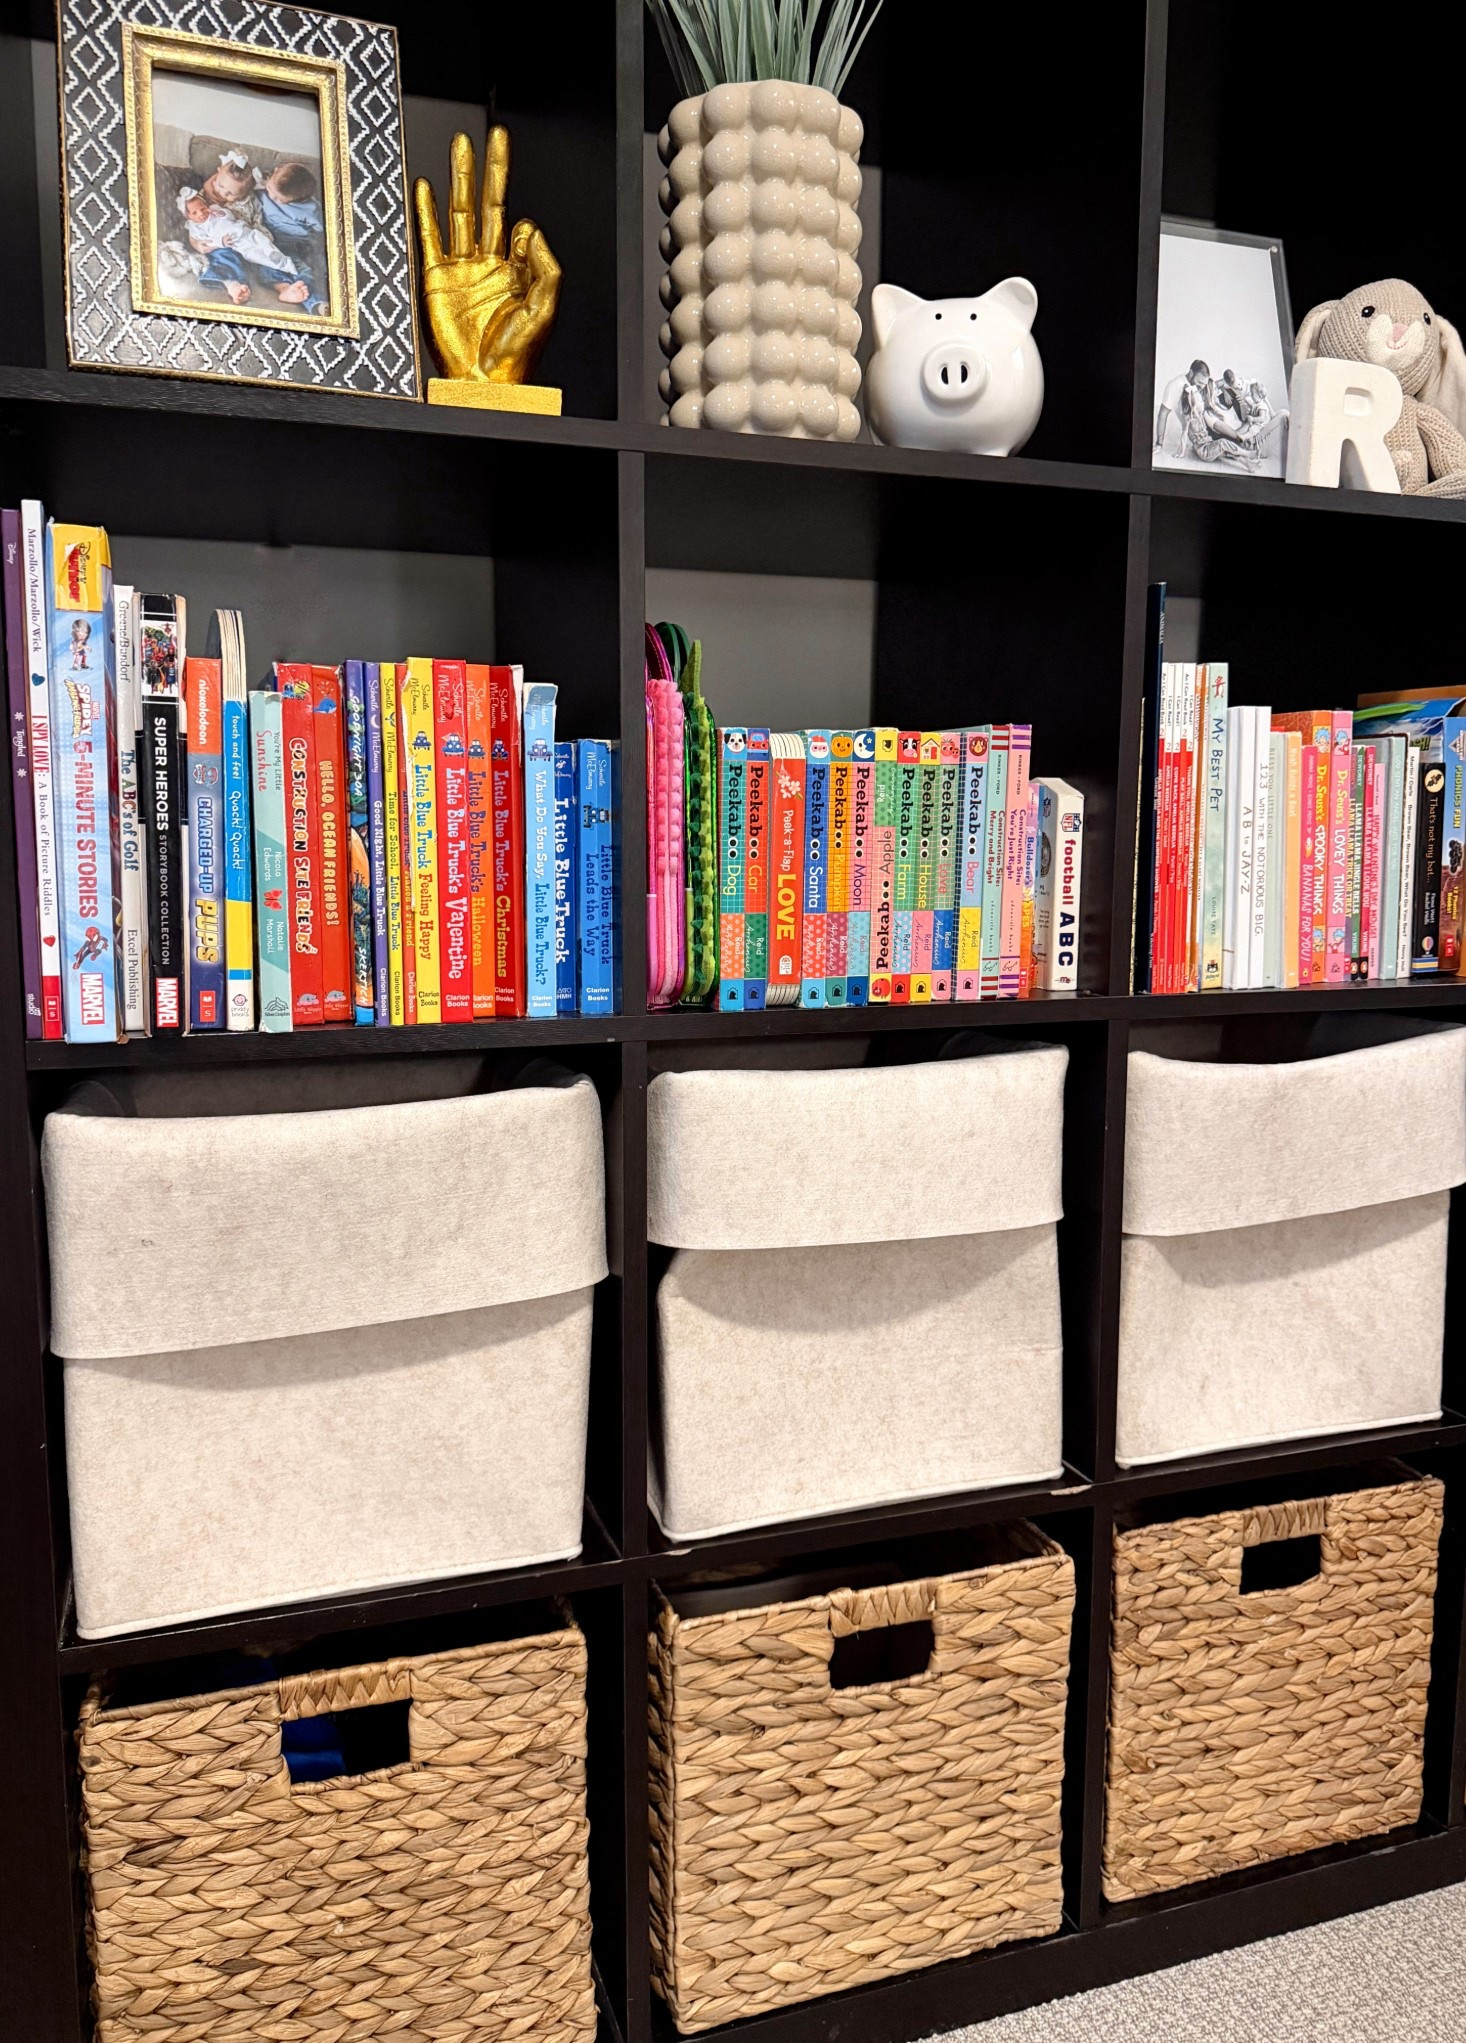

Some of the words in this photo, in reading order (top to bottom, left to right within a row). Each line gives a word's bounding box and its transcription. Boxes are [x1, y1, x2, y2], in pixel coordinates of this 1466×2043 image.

[78, 684, 93, 736] SPIDEY
[198, 680, 209, 744] nickelodeon
[232, 715, 240, 738] touch
[13, 729, 26, 757] Tangled
[33, 722, 48, 742] SPY
[154, 717, 167, 766] SUPER
[232, 742, 240, 758] and
[351, 695, 362, 771] GOODNIGHT
[121, 751, 136, 774] The
[232, 762, 241, 779] feel
[257, 730, 272, 791] Sunshine
[273, 756, 281, 766] My
[1211, 749, 1223, 780] BEST
[1317, 765, 1327, 782] Dr.
[1336, 770, 1347, 786] Dr.
[39, 781, 47, 790] A
[73, 741, 95, 833] 5-MINUTE
[121, 778, 136, 818] ABC's
[319, 760, 334, 807] HELLO,
[415, 765, 432, 797] Little
[445, 768, 465, 804] Little
[468, 771, 486, 806] Little
[1455, 765, 1463, 807] PHONICS
[40, 794, 48, 820] Book
[155, 770, 168, 830] HEROES
[229, 791, 242, 828] Quack!
[416, 801, 432, 827] Blue
[1210, 788, 1223, 812] PET
[1258, 797, 1266, 819] WITH
[1316, 784, 1327, 821] Seuss's
[1335, 789, 1347, 824] Seuss's
[1354, 803, 1362, 830] LLAMA
[1429, 797, 1438, 823] That's
[41, 825, 49, 836] of
[123, 822, 137, 836] of
[321, 811, 336, 857] OCEAN
[447, 809, 465, 838] Blue
[470, 811, 486, 838] Blue
[555, 798, 569, 852] Little
[988, 810, 996, 836] Merry
[1064, 815, 1073, 831] NFL
[1428, 826, 1436, 841] not
[1453, 809, 1462, 828] FUN
[124, 840, 139, 871] Golf
[197, 797, 214, 893] CHARGED-UP
[230, 832, 243, 869] Quack!
[417, 829, 432, 869] Truck
[781, 809, 794, 872] Peek-a-Flap
[877, 831, 894, 874] Apple
[996, 810, 1005, 865] Construction
[1314, 824, 1326, 871] SPOOKY
[1334, 829, 1345, 866] LOVEY
[1353, 834, 1361, 860] LLAMA
[1426, 844, 1435, 858] my
[41, 839, 51, 874] Picture
[159, 834, 168, 897] STORYBOOK
[264, 848, 273, 881] Edwards
[448, 841, 465, 893] Truck's
[471, 841, 487, 892] Truck's
[586, 854, 600, 894] Leads
[601, 845, 614, 881] Little
[986, 857, 995, 884] Bright
[1025, 836, 1034, 885] Bulldozer's
[1062, 839, 1076, 905] football
[1241, 851, 1251, 894] JAY-Z
[75, 839, 98, 918] STORIES
[323, 861, 339, 925] FRIENDS!
[418, 874, 432, 916] Feeling
[556, 859, 570, 899] Blue
[723, 865, 741, 896] Dog
[749, 865, 762, 893] Car
[809, 866, 823, 908] Santa
[832, 854, 846, 911] Pumpkin
[853, 864, 866, 905] Moon
[897, 864, 911, 900] Farm
[919, 864, 932, 909] House
[938, 863, 952, 894] Love
[966, 861, 979, 893] Bear
[995, 868, 1003, 887] Site:
[1255, 847, 1265, 908] NOTORIOUS
[1302, 864, 1313, 914] BANANAS
[1313, 874, 1324, 915] THINGS
[1332, 874, 1344, 914] THINGS
[43, 879, 52, 916] Riddles
[586, 900, 598, 921] the
[601, 886, 614, 917] Blue
[777, 874, 796, 940] LOVE
[161, 900, 170, 965] COLLECTION
[195, 899, 218, 962] PUPS
[267, 919, 276, 953] Marshall
[277, 921, 285, 951] Natalie
[445, 897, 468, 979] Valentine
[472, 896, 485, 966] Halloween
[556, 902, 570, 964] Truck
[1060, 912, 1075, 928] A
[1301, 916, 1311, 932] FOR
[127, 929, 138, 956] Excel
[419, 920, 434, 960] Happy
[584, 926, 599, 957] Way
[602, 923, 614, 964] Truck
[1060, 932, 1074, 947] B
[1301, 935, 1312, 961] YOU!
[1058, 951, 1073, 966] C
[81, 973, 104, 1024] MARVEL
[127, 959, 140, 1010] Publishing
[157, 979, 178, 1026] MARVEL
